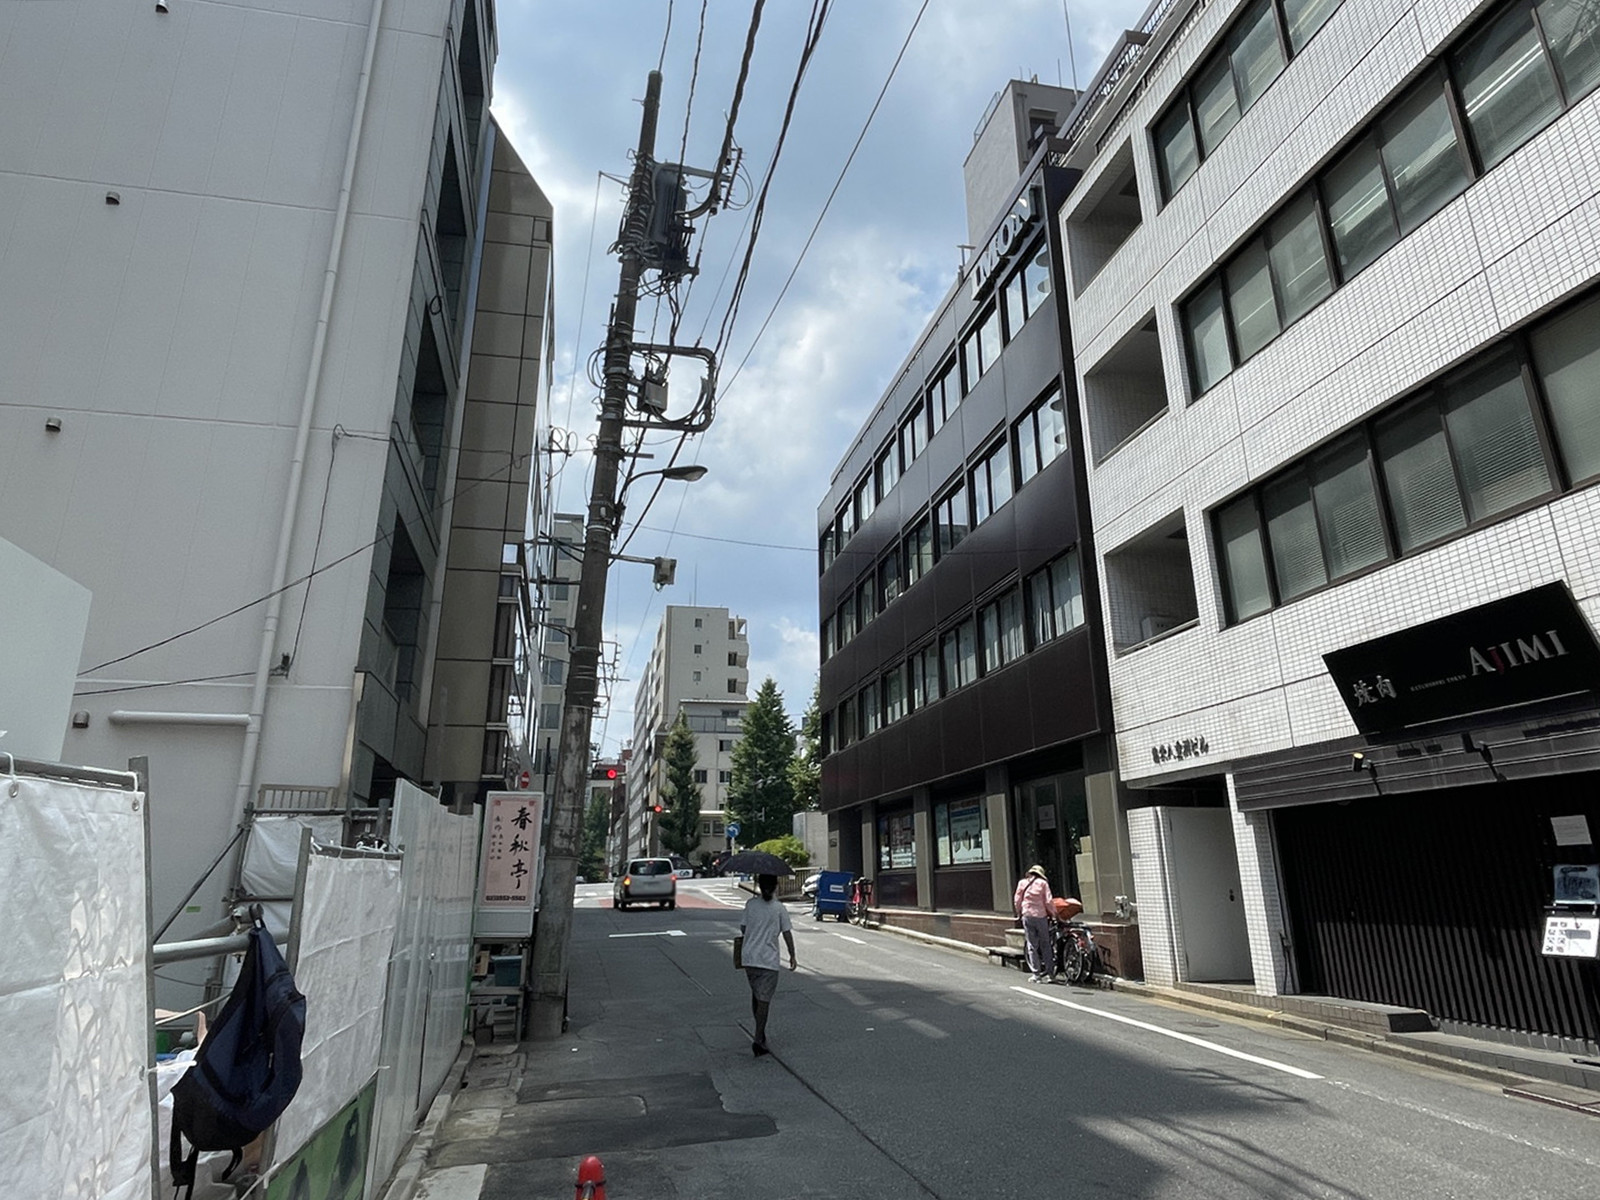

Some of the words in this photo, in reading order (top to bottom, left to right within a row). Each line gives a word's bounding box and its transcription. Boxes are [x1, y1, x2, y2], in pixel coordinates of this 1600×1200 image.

[1469, 629, 1570, 676] AJIMI
[1352, 674, 1397, 708] 焼肉
[508, 805, 532, 890] 春秋亭
